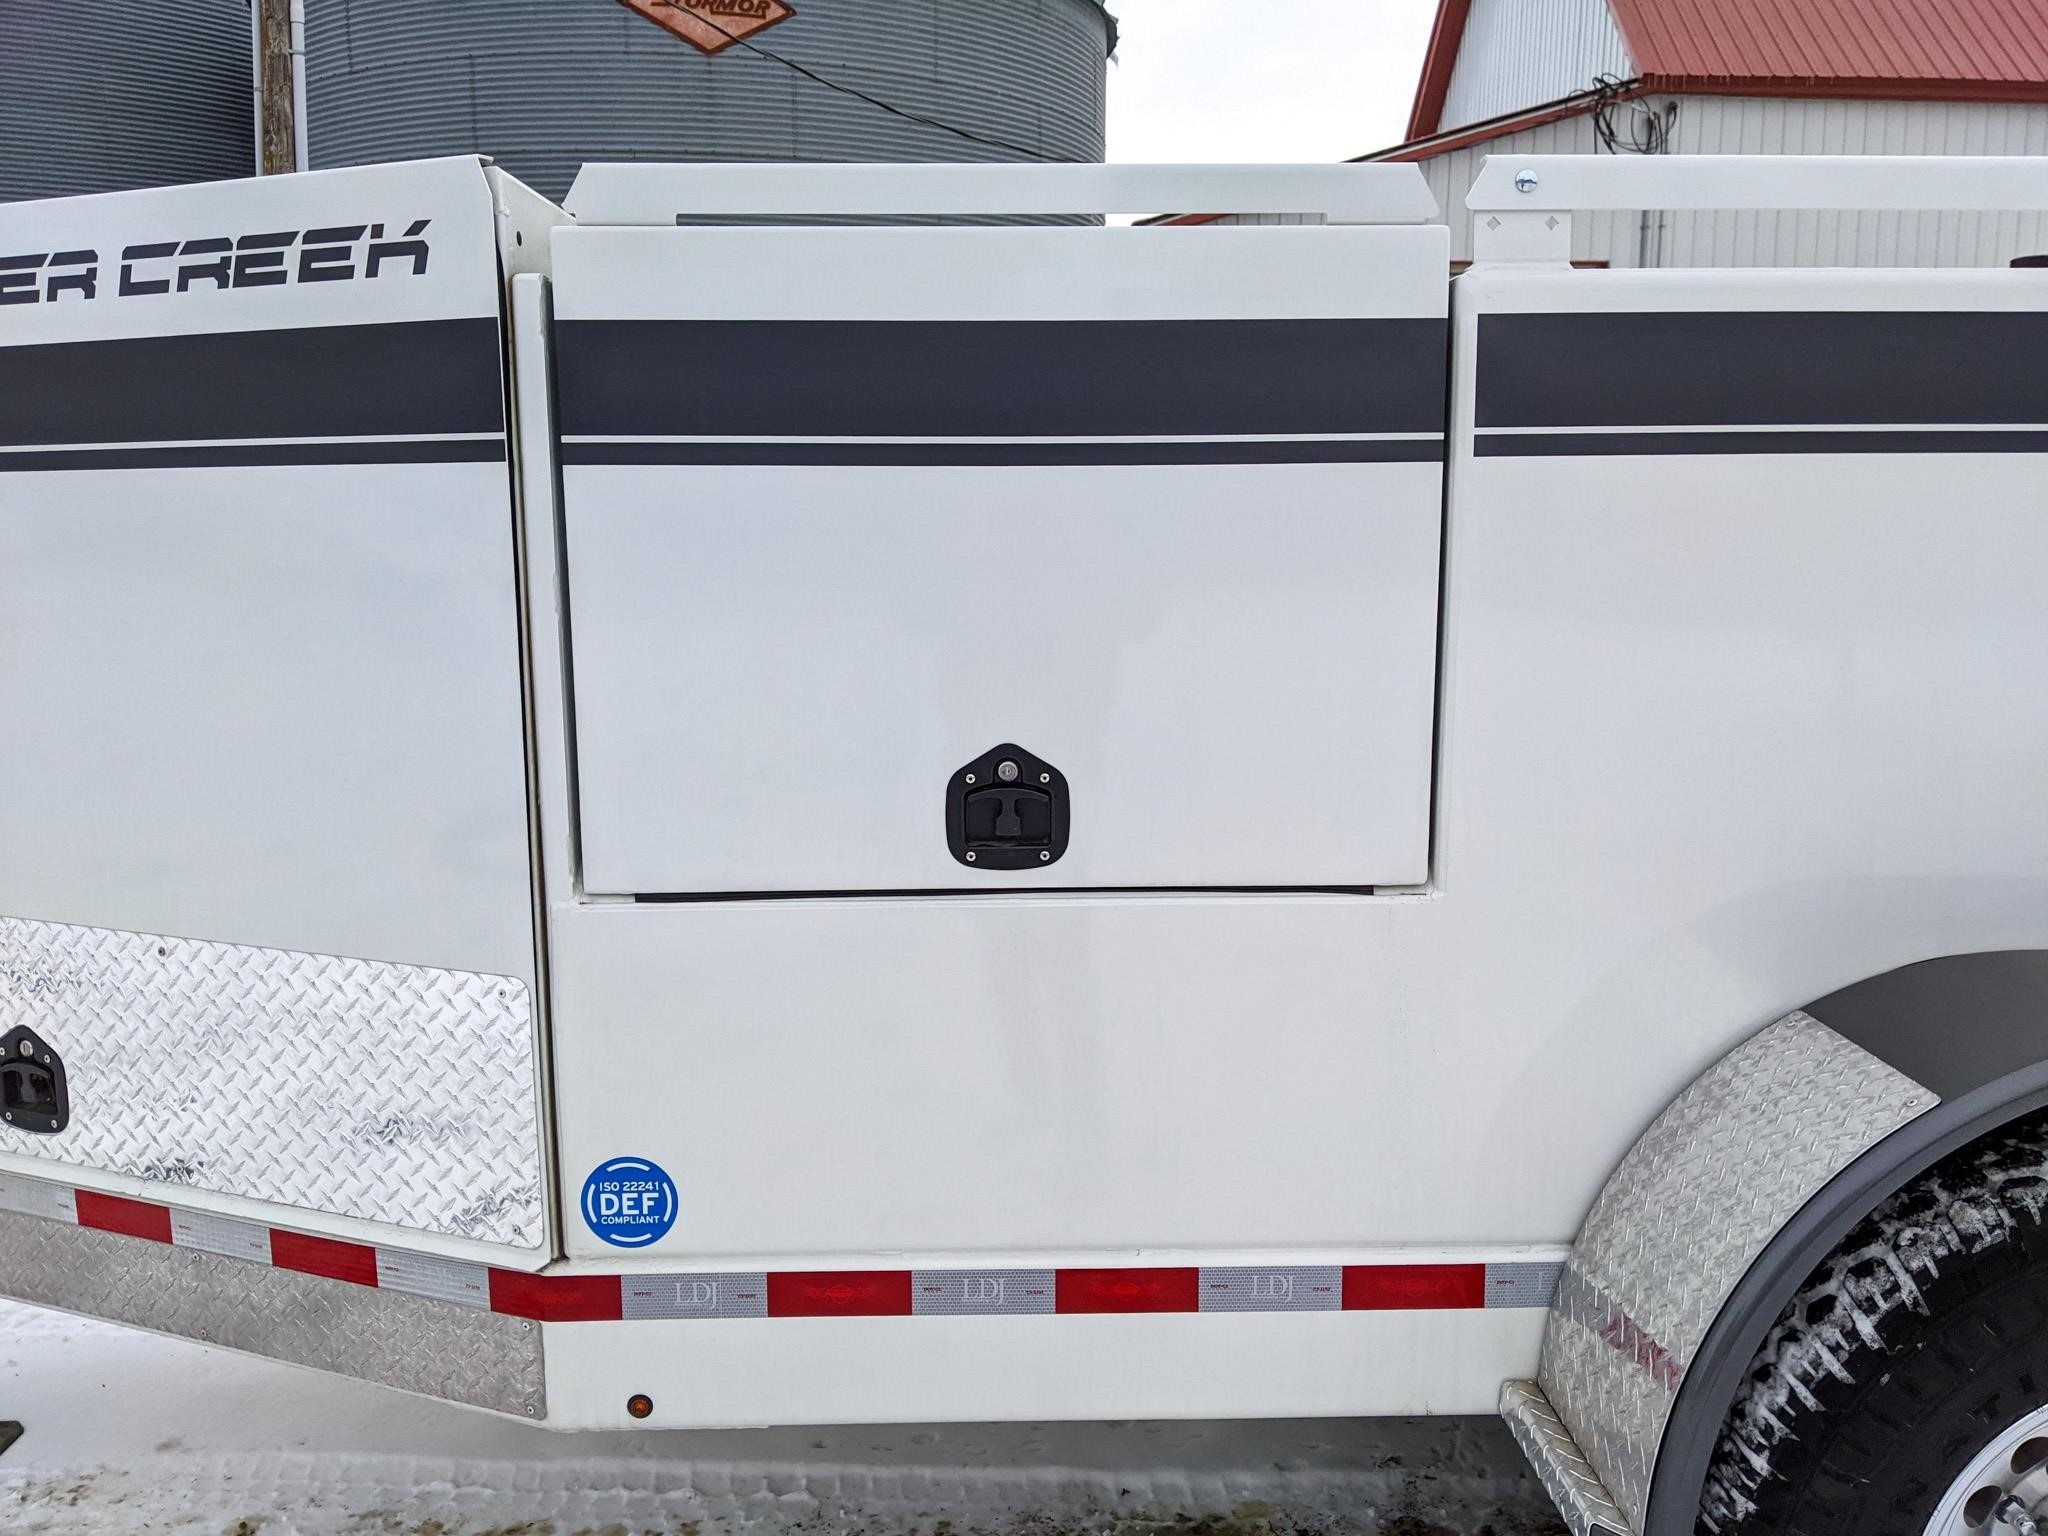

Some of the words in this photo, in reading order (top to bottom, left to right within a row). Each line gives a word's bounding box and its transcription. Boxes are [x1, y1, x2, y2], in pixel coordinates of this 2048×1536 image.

[650, 0, 771, 17] ORMOR
[118, 219, 432, 297] CREEK
[599, 1181, 620, 1192] ISO
[622, 1181, 659, 1192] 22241
[600, 1192, 660, 1216] DEF
[601, 1215, 660, 1225] COMPLIANT
